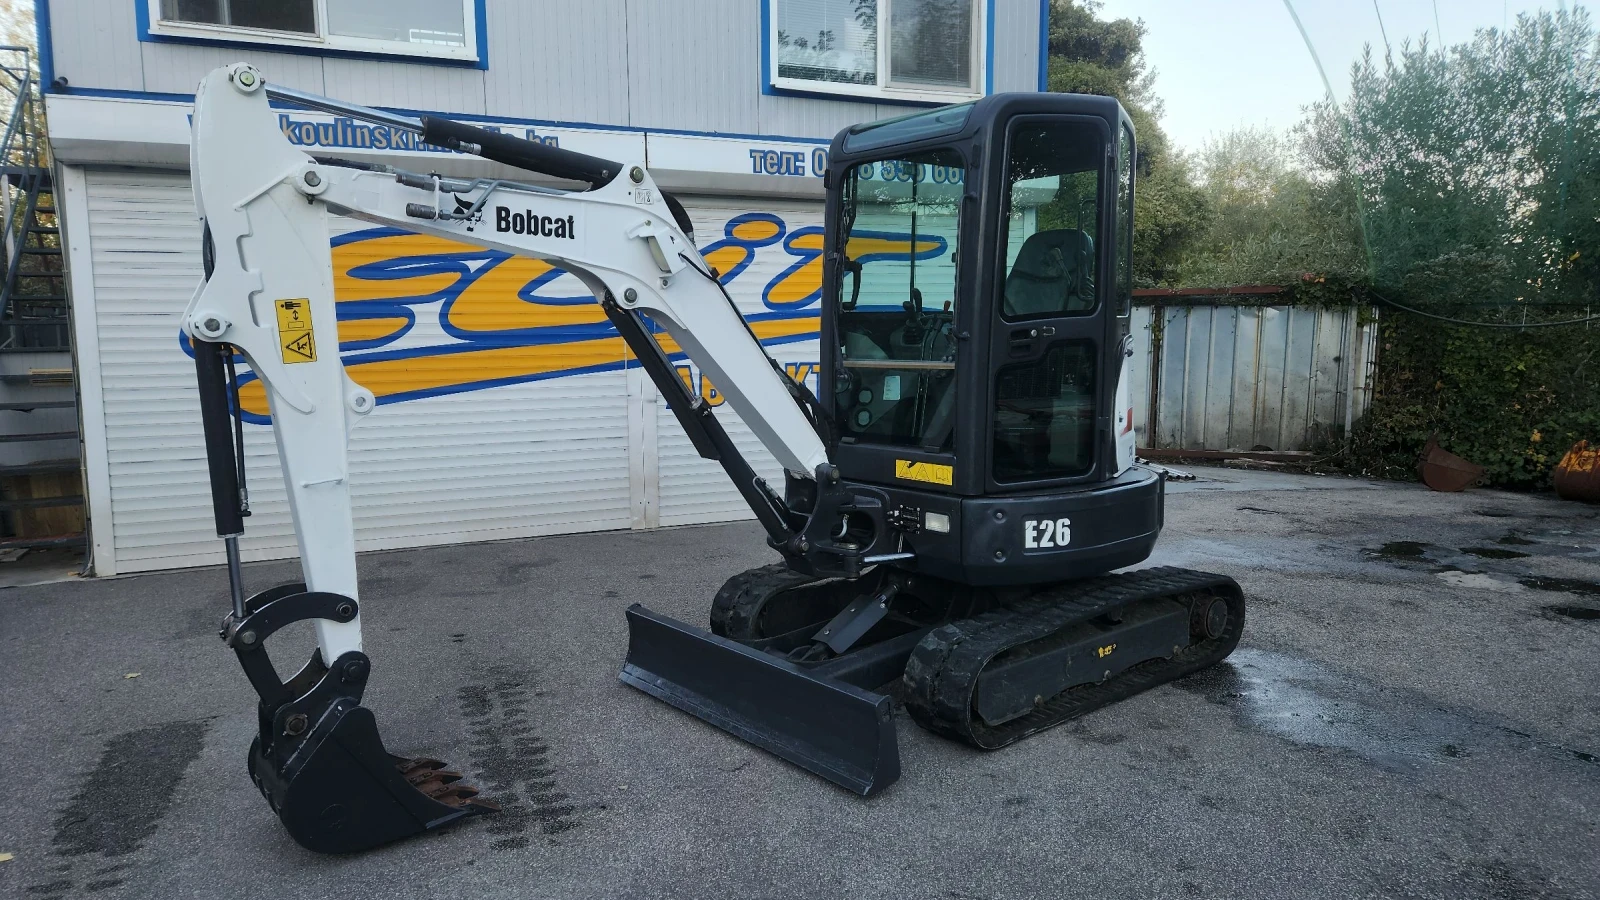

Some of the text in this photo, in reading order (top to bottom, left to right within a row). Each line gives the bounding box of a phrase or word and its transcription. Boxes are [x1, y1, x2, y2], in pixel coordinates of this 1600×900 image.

[750, 149, 805, 176] тел:
[496, 206, 575, 239] Bobcat
[1025, 518, 1071, 549] E26
